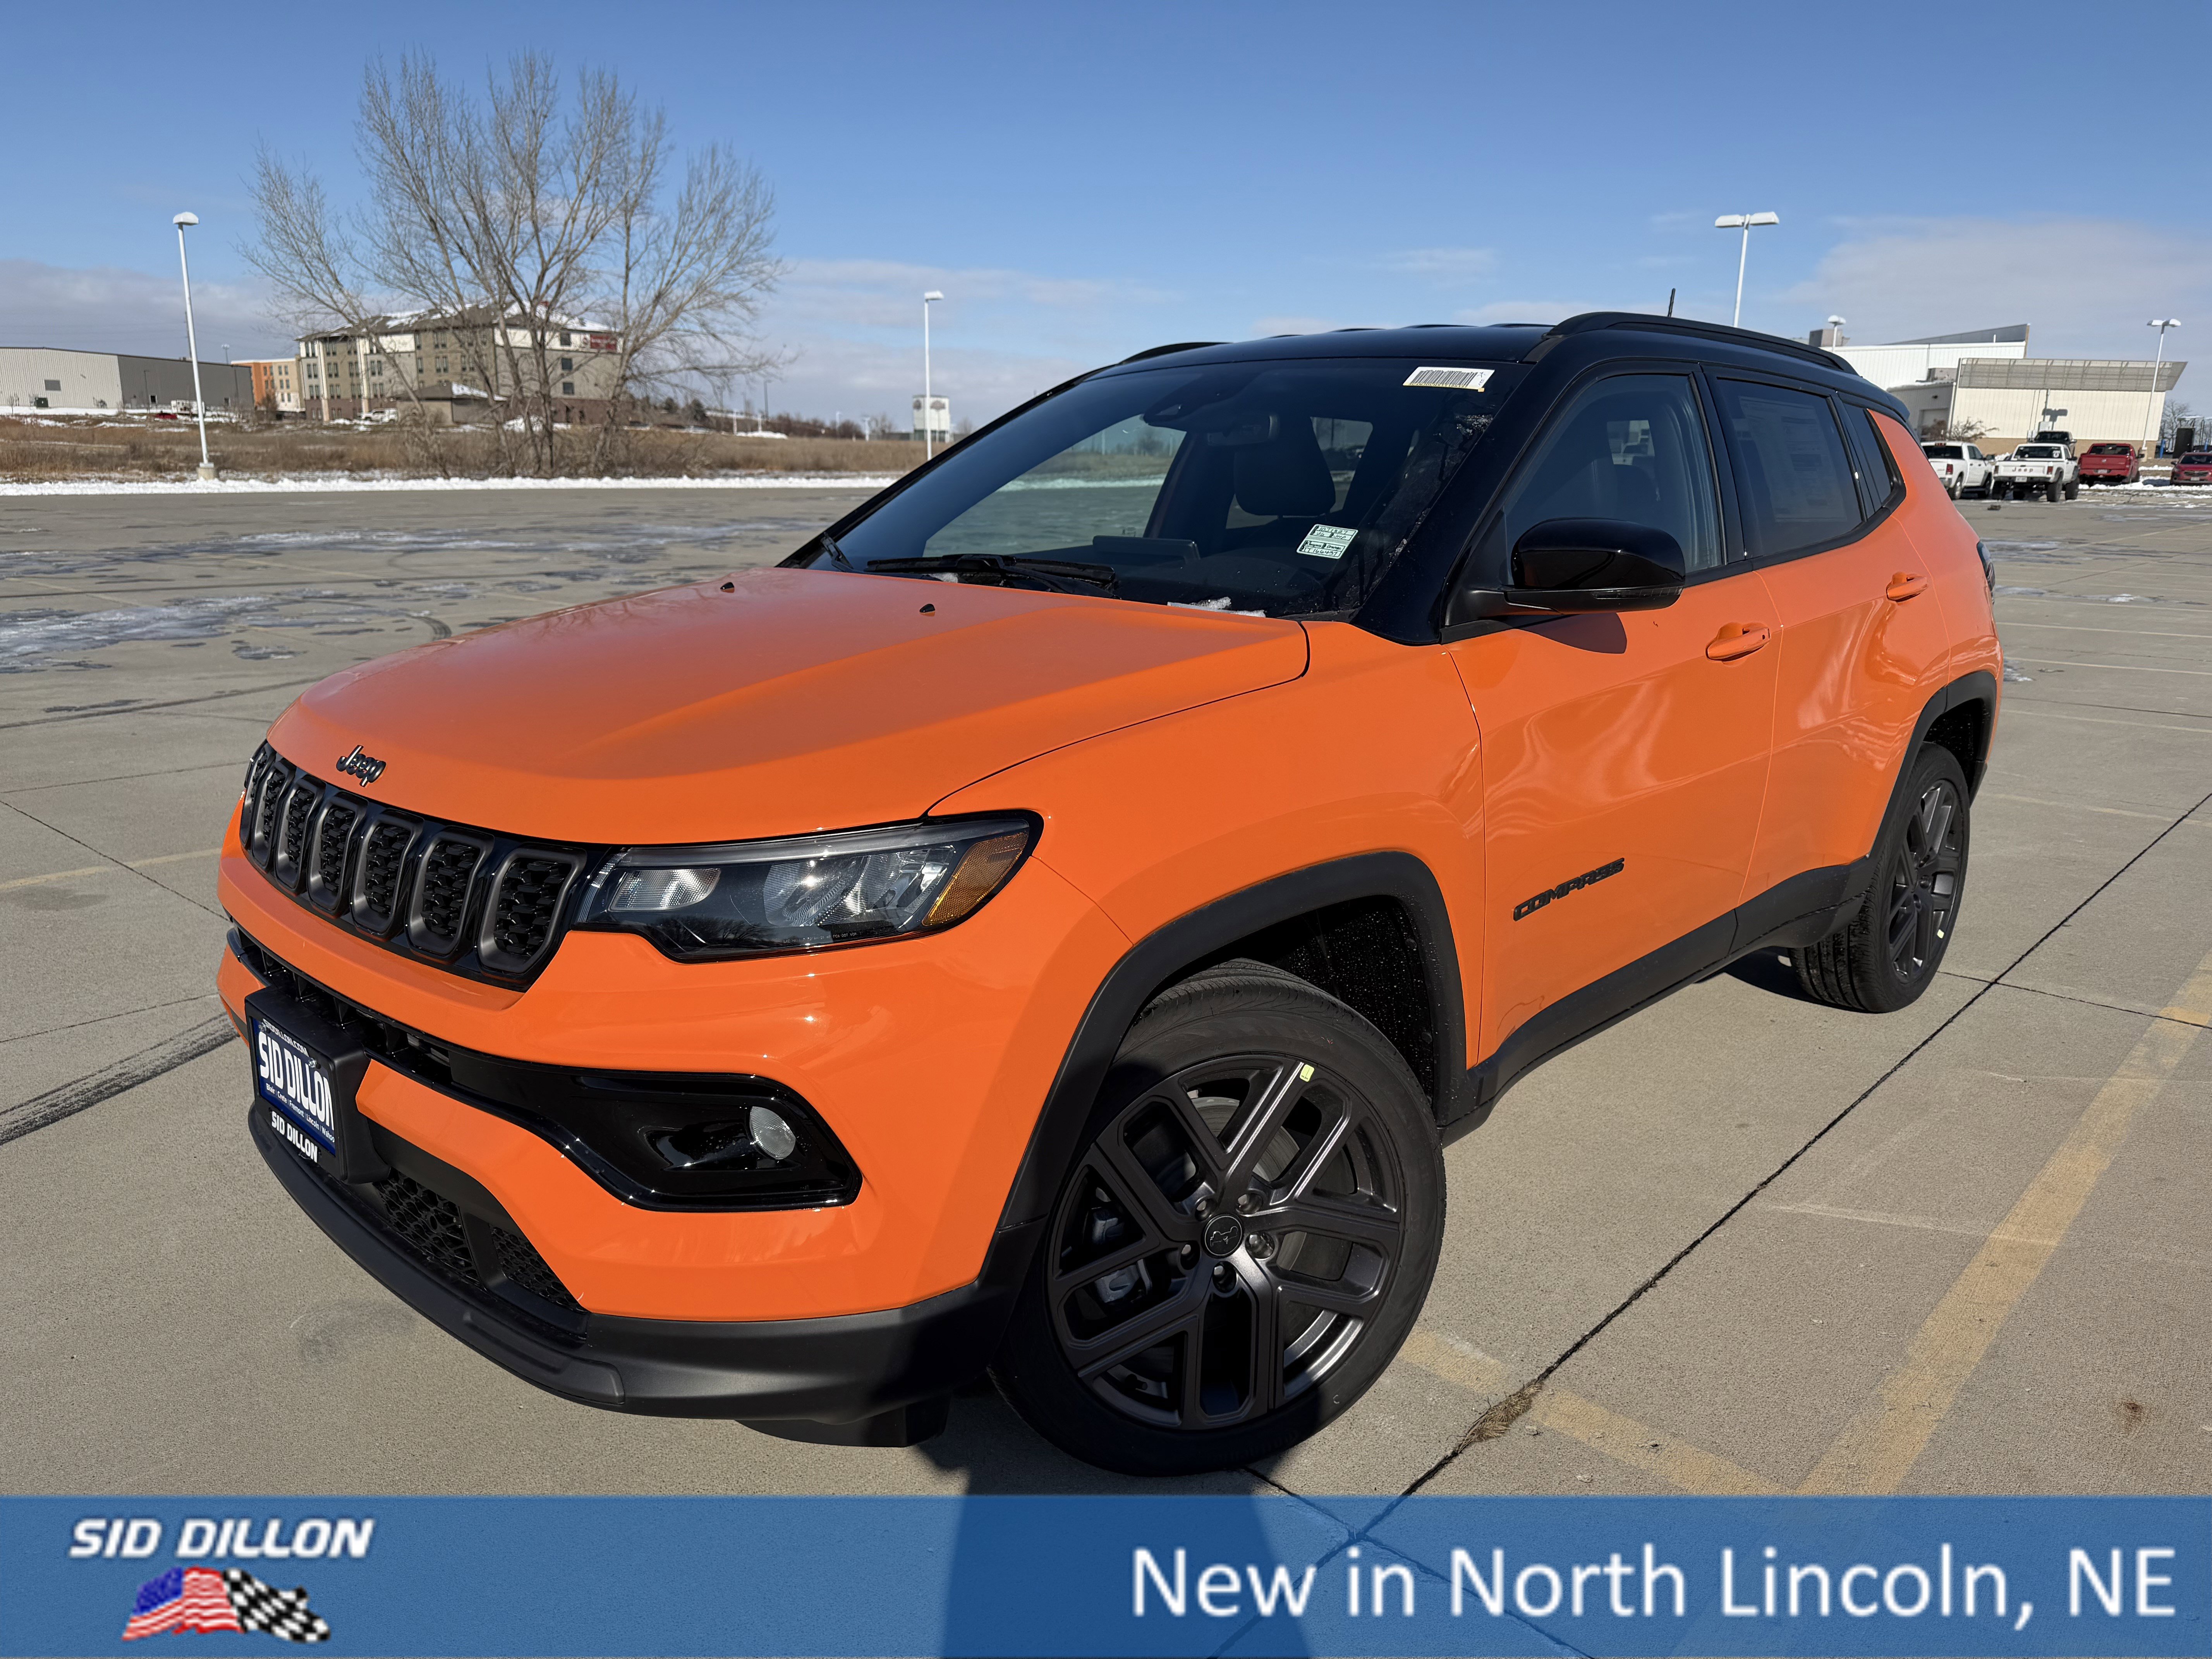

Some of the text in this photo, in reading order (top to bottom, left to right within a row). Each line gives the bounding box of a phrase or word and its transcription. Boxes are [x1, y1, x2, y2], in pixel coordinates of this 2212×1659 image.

[336, 745, 386, 787] Jeep
[1513, 857, 1625, 922] COMPASS
[259, 1031, 334, 1131] SID DILLON
[278, 1091, 287, 1103] Crete
[289, 1100, 304, 1118] Fremont
[306, 1113, 319, 1130] Lincoln
[272, 1111, 317, 1163] SID DILLON
